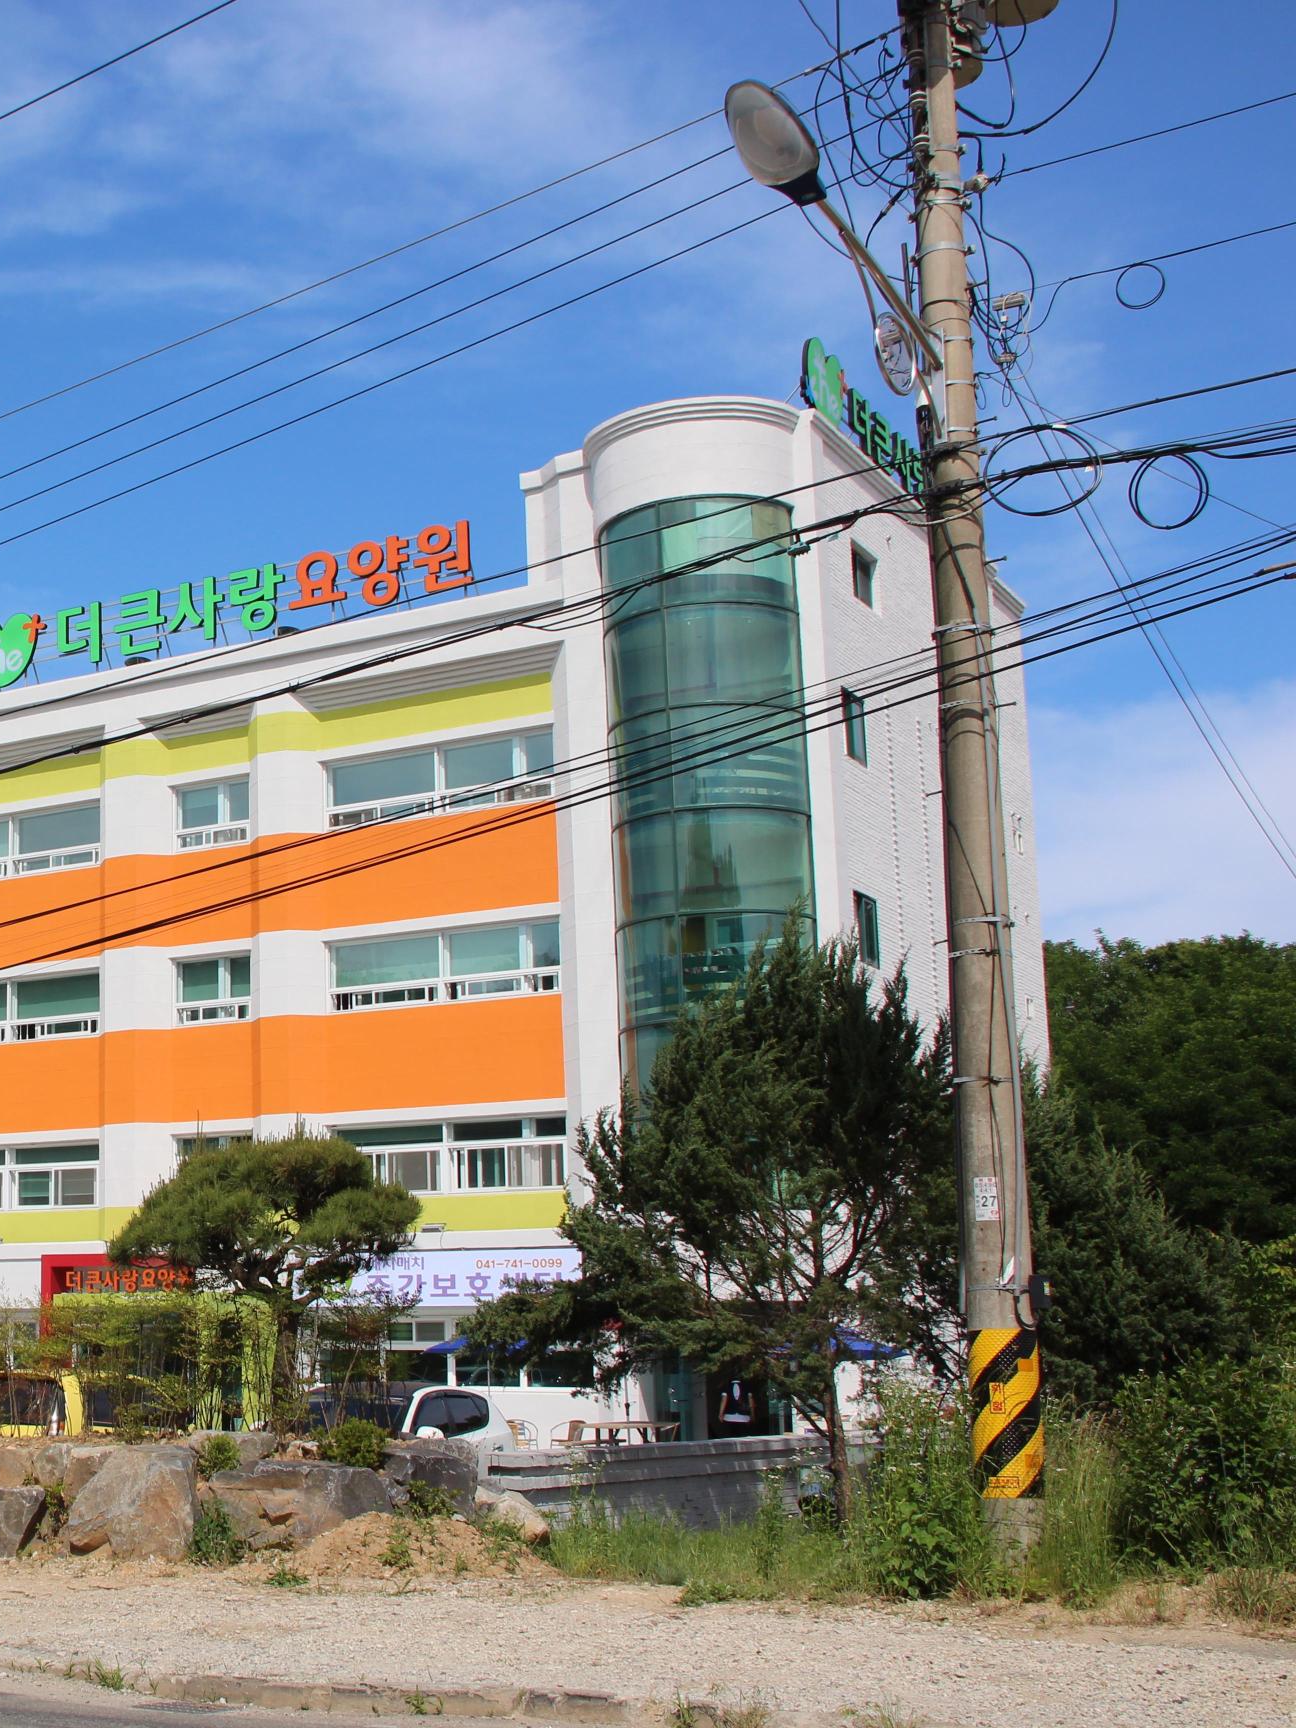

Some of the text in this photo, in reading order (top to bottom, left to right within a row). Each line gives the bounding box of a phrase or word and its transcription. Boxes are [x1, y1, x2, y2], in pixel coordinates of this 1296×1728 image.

[288, 519, 473, 611] 요양원
[981, 1195, 997, 1207] 27
[476, 1258, 562, 1269] 041-741-0099
